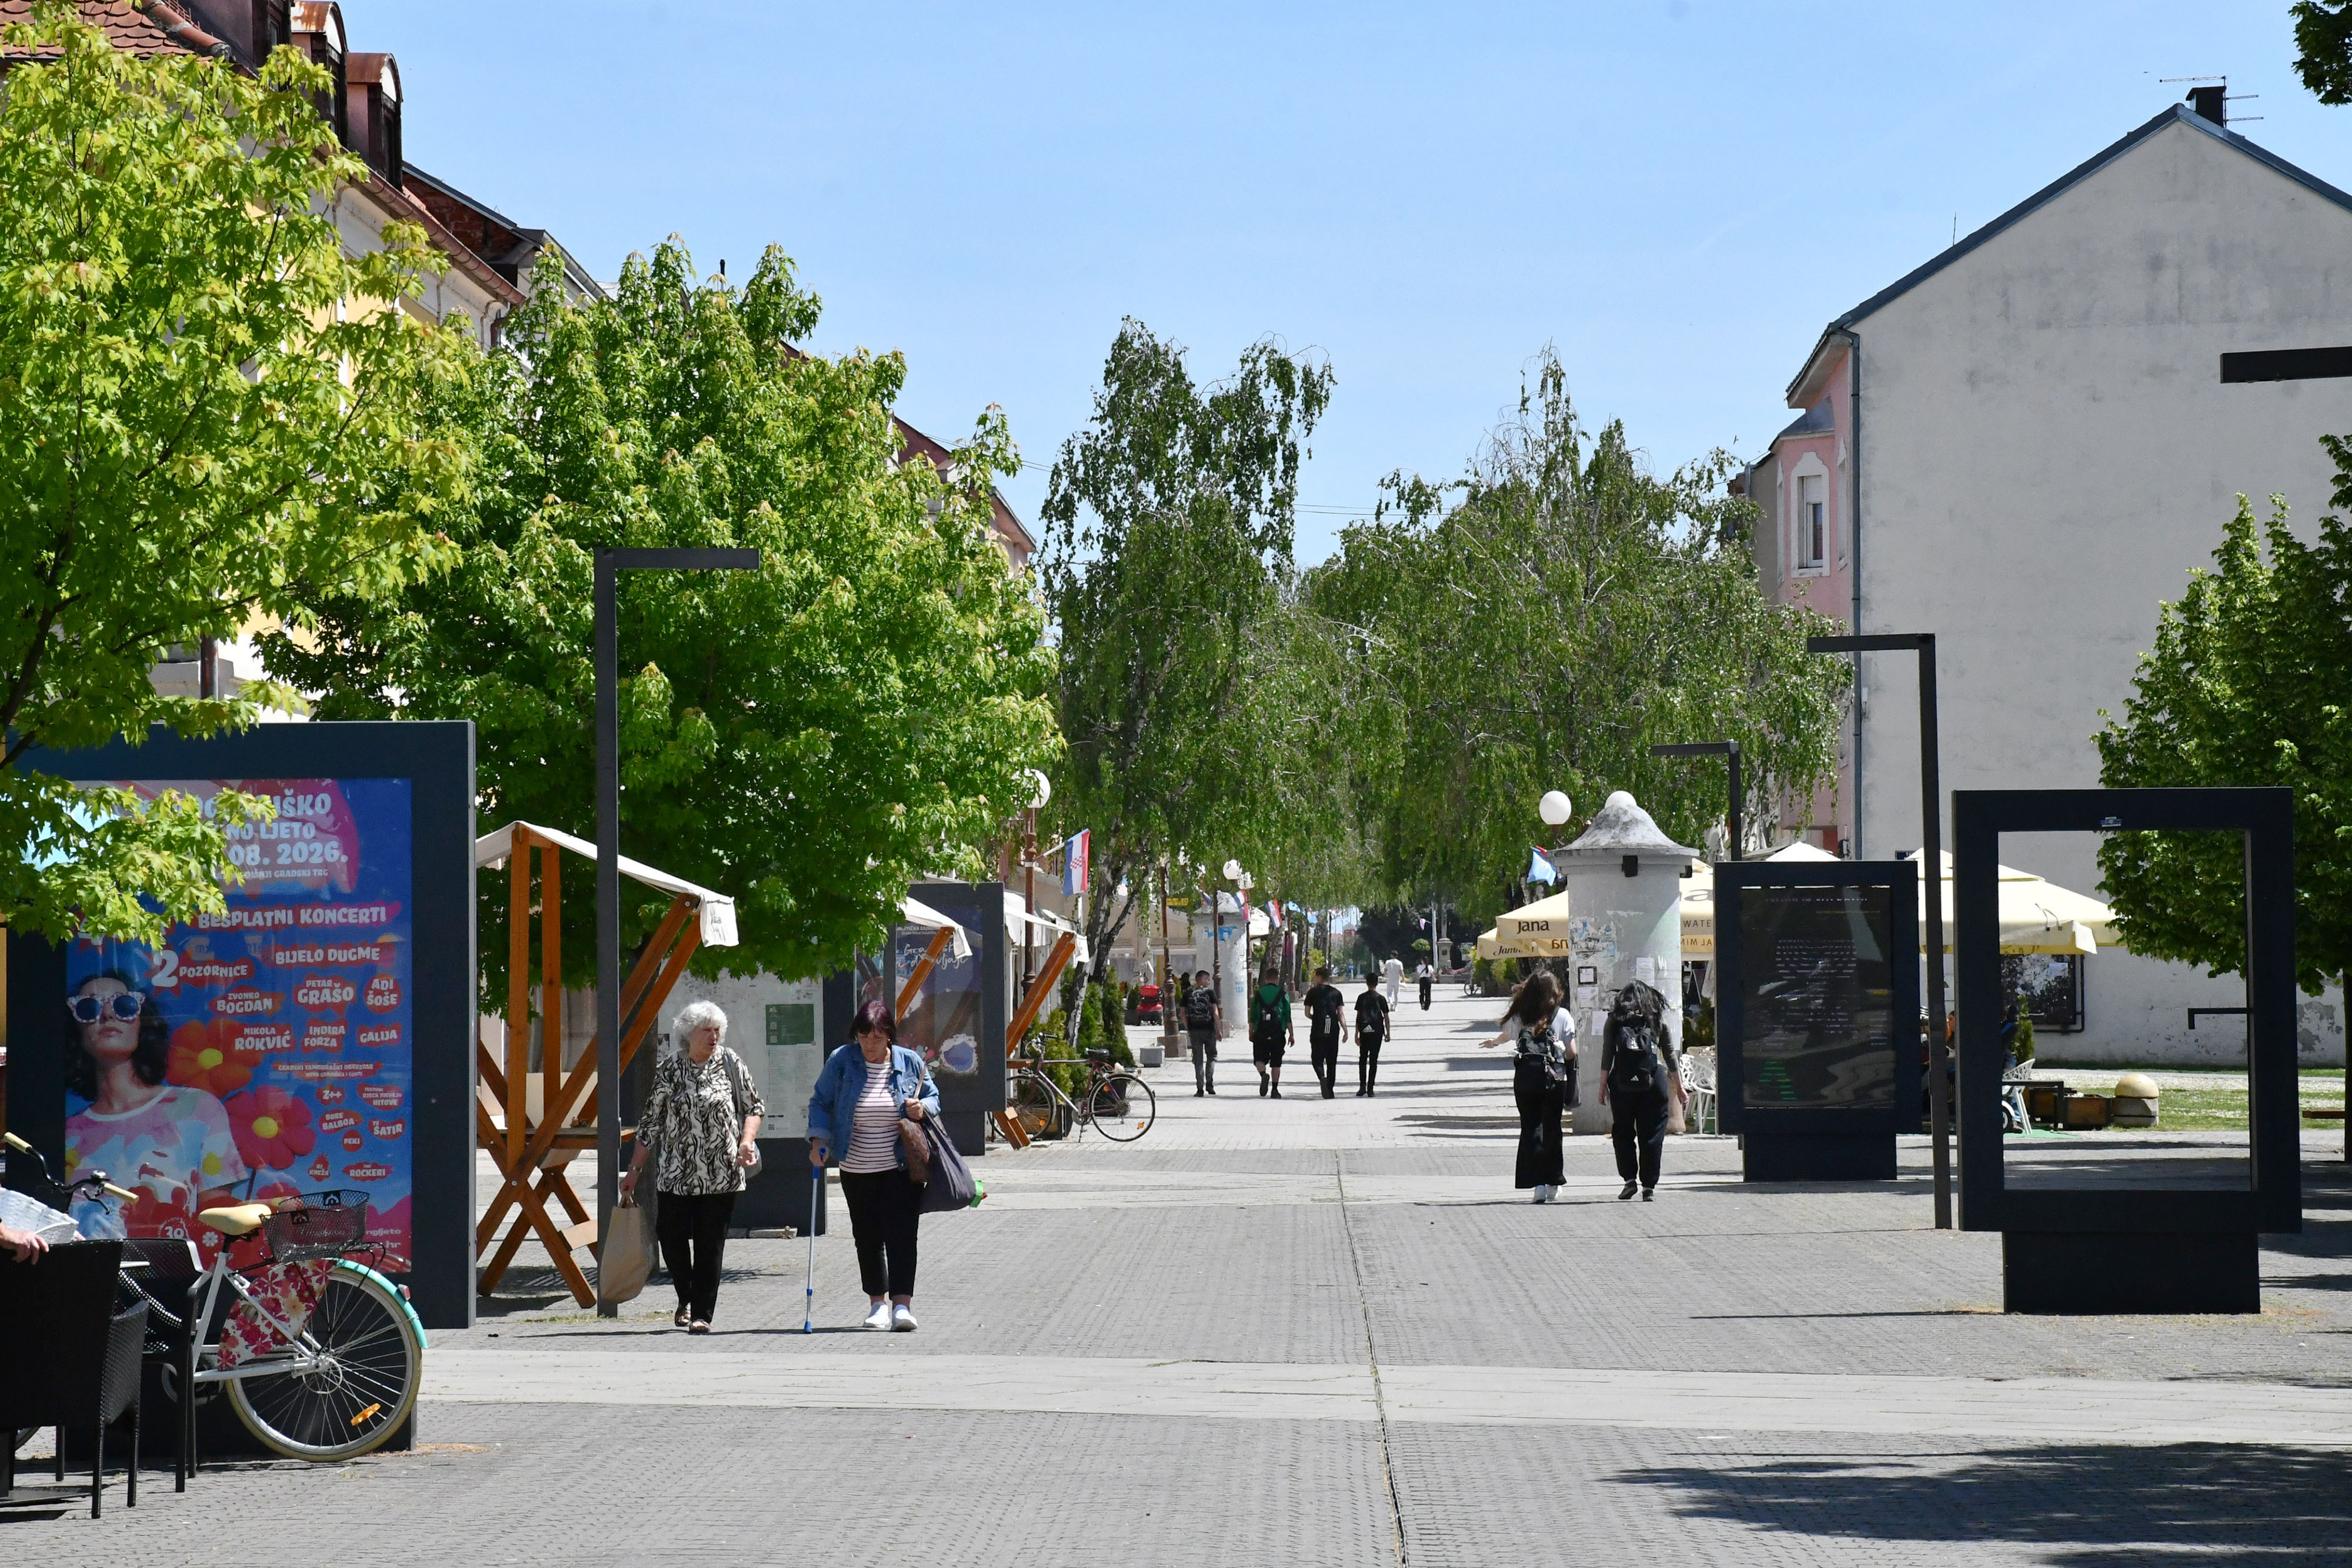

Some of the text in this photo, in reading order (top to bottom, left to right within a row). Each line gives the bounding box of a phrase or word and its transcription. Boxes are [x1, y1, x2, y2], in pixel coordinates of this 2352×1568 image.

[259, 822, 315, 839] LJETO
[228, 841, 348, 865] 08. 2026.
[274, 870, 310, 878] GRADSKI
[199, 907, 386, 928] BESPLATNI KONCERTI
[1683, 919, 1712, 927] WATE
[275, 946, 380, 964] BIJELO DUGME
[151, 950, 178, 987] 2
[179, 965, 248, 978] POZORNICE
[371, 978, 393, 991] ADI
[298, 982, 354, 1004] GRAŠO
[367, 990, 397, 1006] ŠOŠE
[216, 998, 273, 1014] BOGDAN
[309, 1025, 346, 1035] INDIRA
[360, 1029, 397, 1043] GALIJA
[235, 1031, 291, 1051] ROKVIĆ
[304, 1038, 337, 1047] FORZA
[322, 1118, 355, 1130] BALBOA
